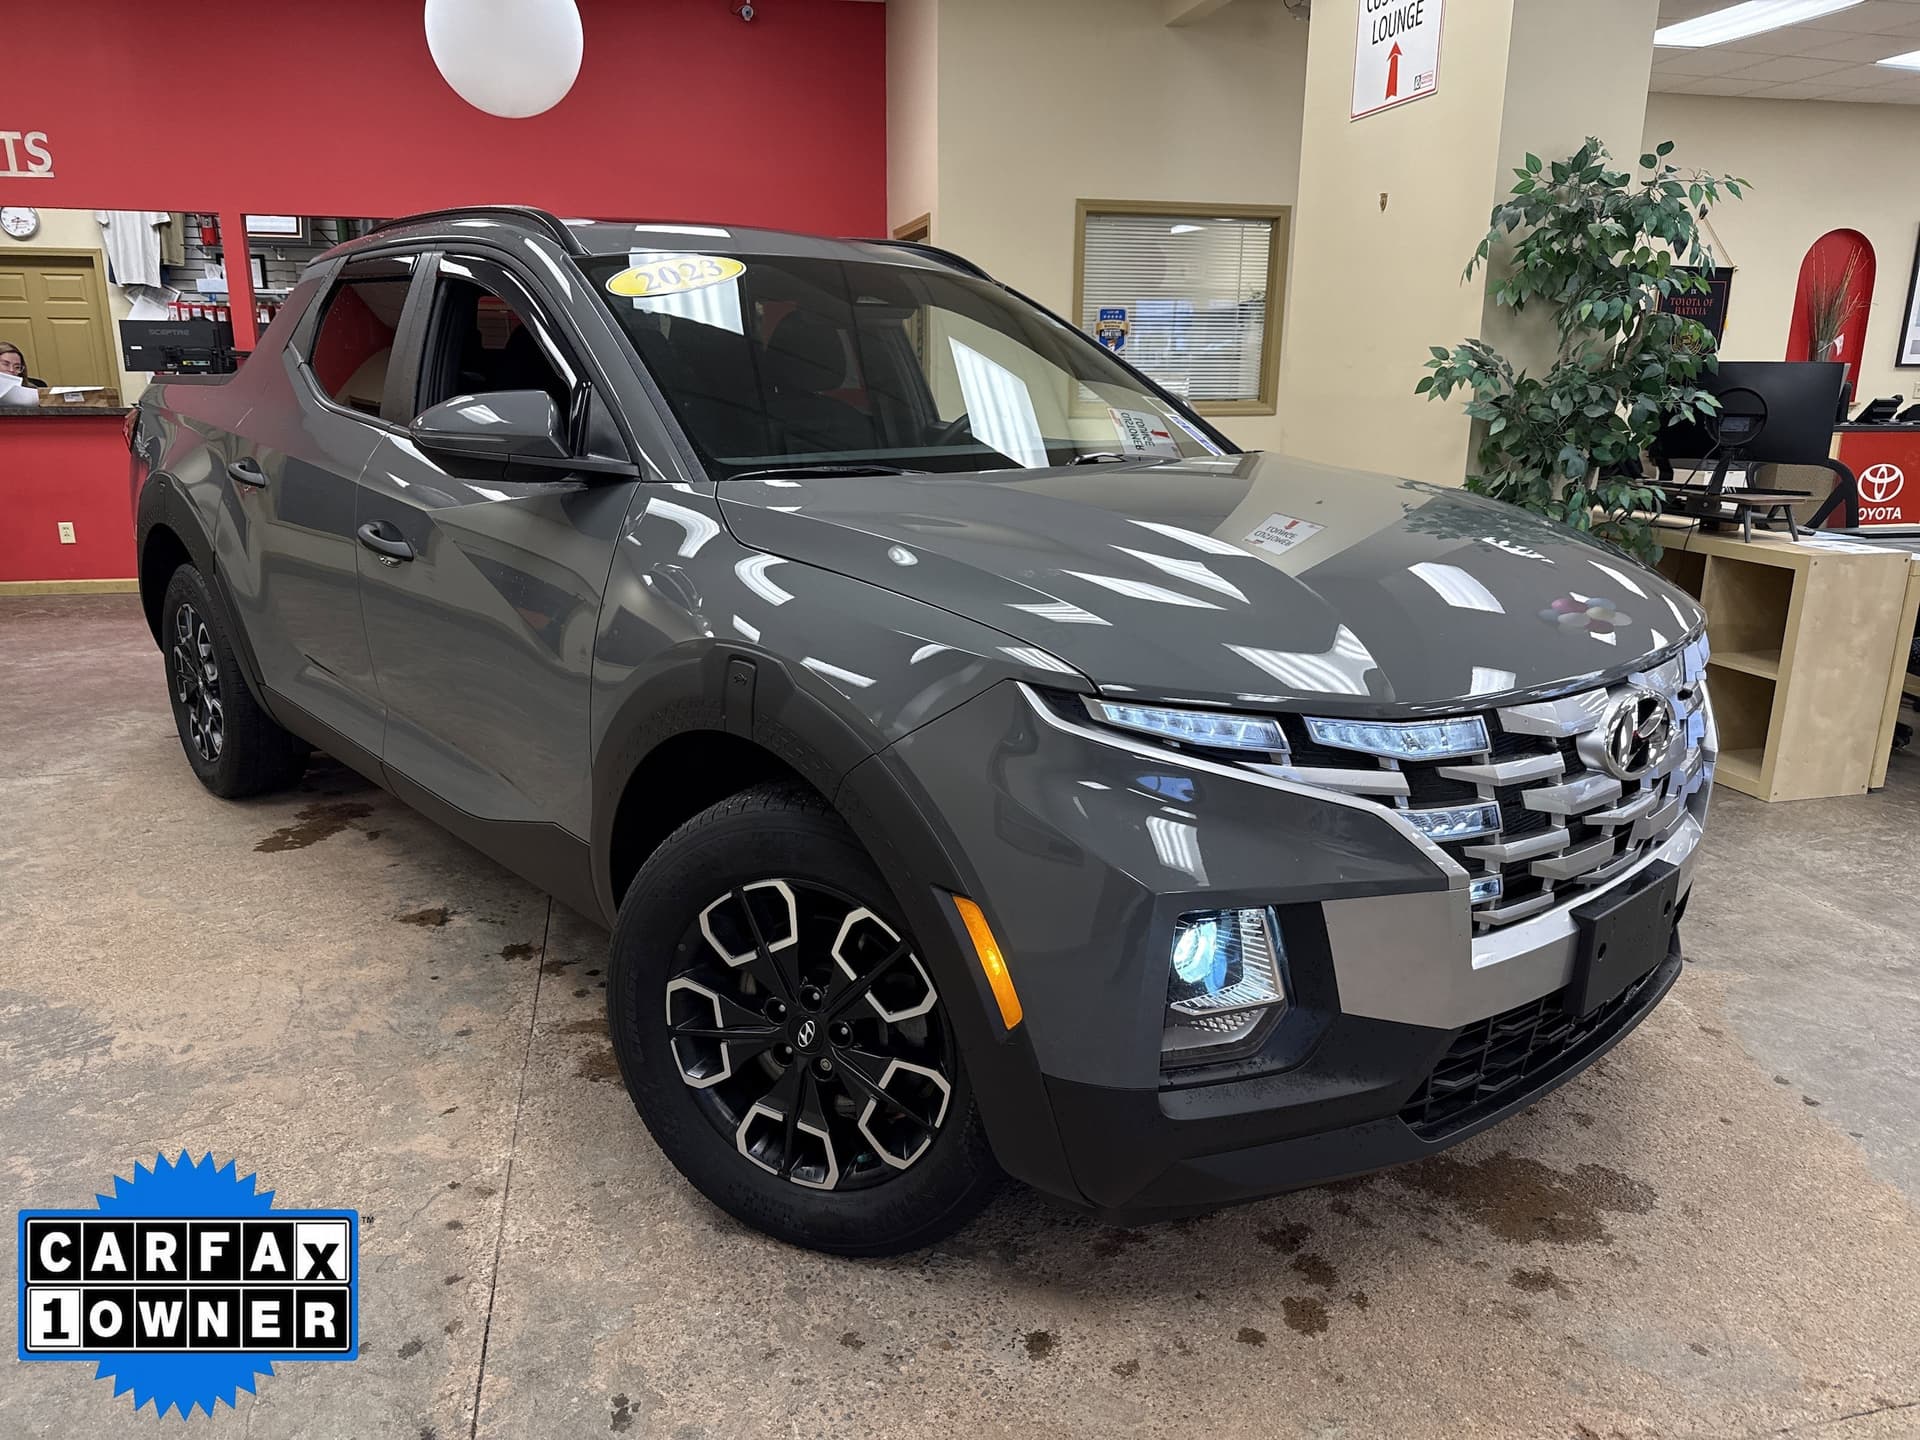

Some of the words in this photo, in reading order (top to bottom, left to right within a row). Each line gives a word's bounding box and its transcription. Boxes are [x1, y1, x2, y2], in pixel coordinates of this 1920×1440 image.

[1372, 0, 1424, 45] LOUNGE
[635, 259, 723, 291] 2023
[1858, 506, 1902, 520] OYOTA
